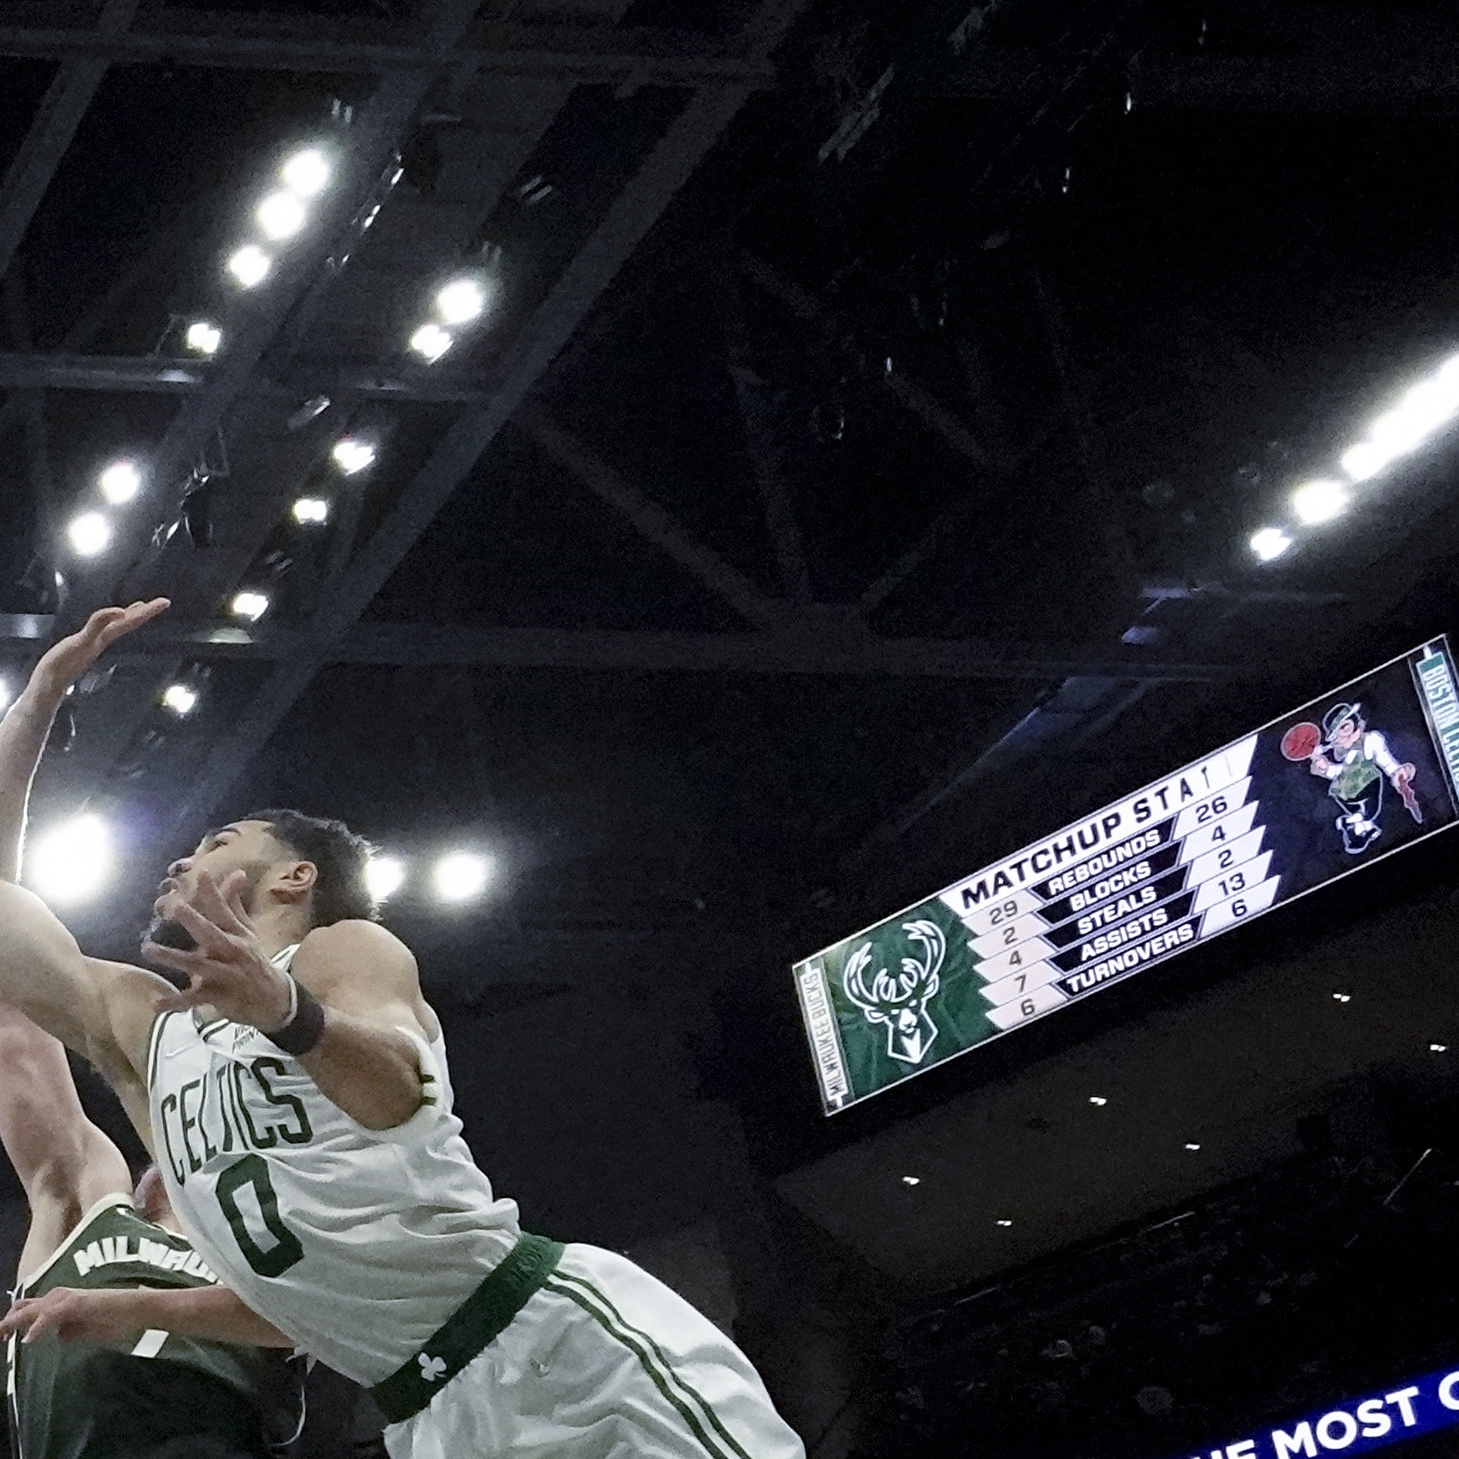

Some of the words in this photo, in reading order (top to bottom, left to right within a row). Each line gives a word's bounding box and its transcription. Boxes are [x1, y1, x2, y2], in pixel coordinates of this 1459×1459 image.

[960, 811, 1122, 909] MATCHUP
[989, 900, 1018, 926] 29
[1048, 829, 1160, 896] REBOUNDS
[1195, 796, 1228, 824] 26
[1003, 926, 1016, 945] 2
[1070, 861, 1152, 911] BLOCKS
[1211, 824, 1226, 842] 4
[1009, 950, 1023, 967] 4
[1078, 886, 1157, 935] STEALS
[1218, 849, 1234, 869] 2
[1014, 974, 1028, 992] 7
[1081, 908, 1168, 961] ASSISTS
[1218, 872, 1246, 896] 13
[1020, 998, 1035, 1017] 6
[1066, 923, 1194, 993] TURNOVERS
[1231, 899, 1248, 917] 6
[803, 971, 827, 1018] BUCKS
[815, 1018, 846, 1096] MILWAUKEE
[160, 1057, 314, 1188] CELTICS
[73, 1235, 219, 1285] MILWAU
[214, 1153, 305, 1278] 0
